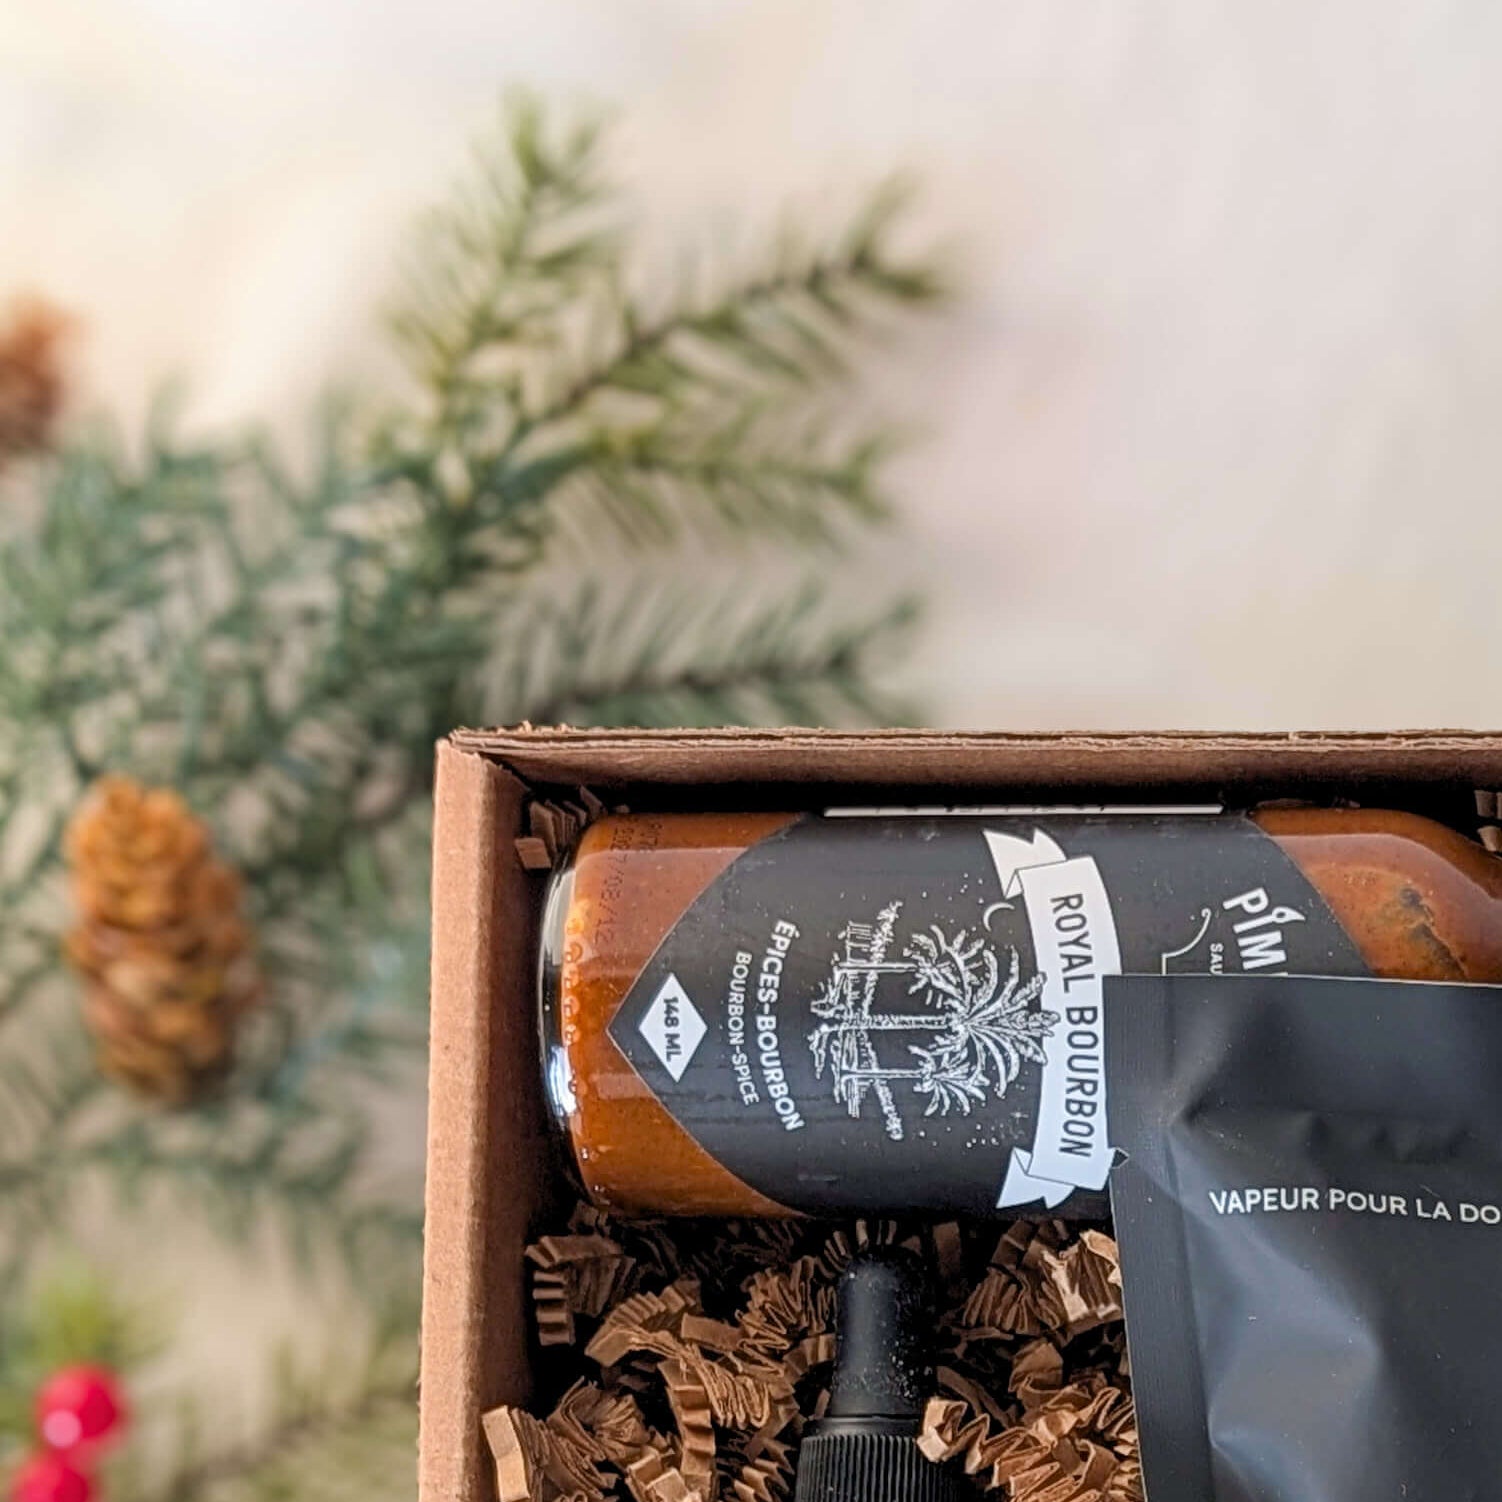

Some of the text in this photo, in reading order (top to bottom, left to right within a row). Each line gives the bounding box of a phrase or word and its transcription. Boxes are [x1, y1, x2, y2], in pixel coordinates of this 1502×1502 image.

[1222, 887, 1306, 976] PIM
[663, 996, 682, 1063] 148 ML
[728, 950, 759, 1106] BOURBON-SPICE
[756, 919, 804, 1132] ÉPICES-BOURBON
[1050, 893, 1099, 1158] ROYAL BOURBON
[1208, 1187, 1320, 1215] VAPEUR
[1328, 1188, 1408, 1216] POUR
[1415, 1198, 1452, 1222] LA
